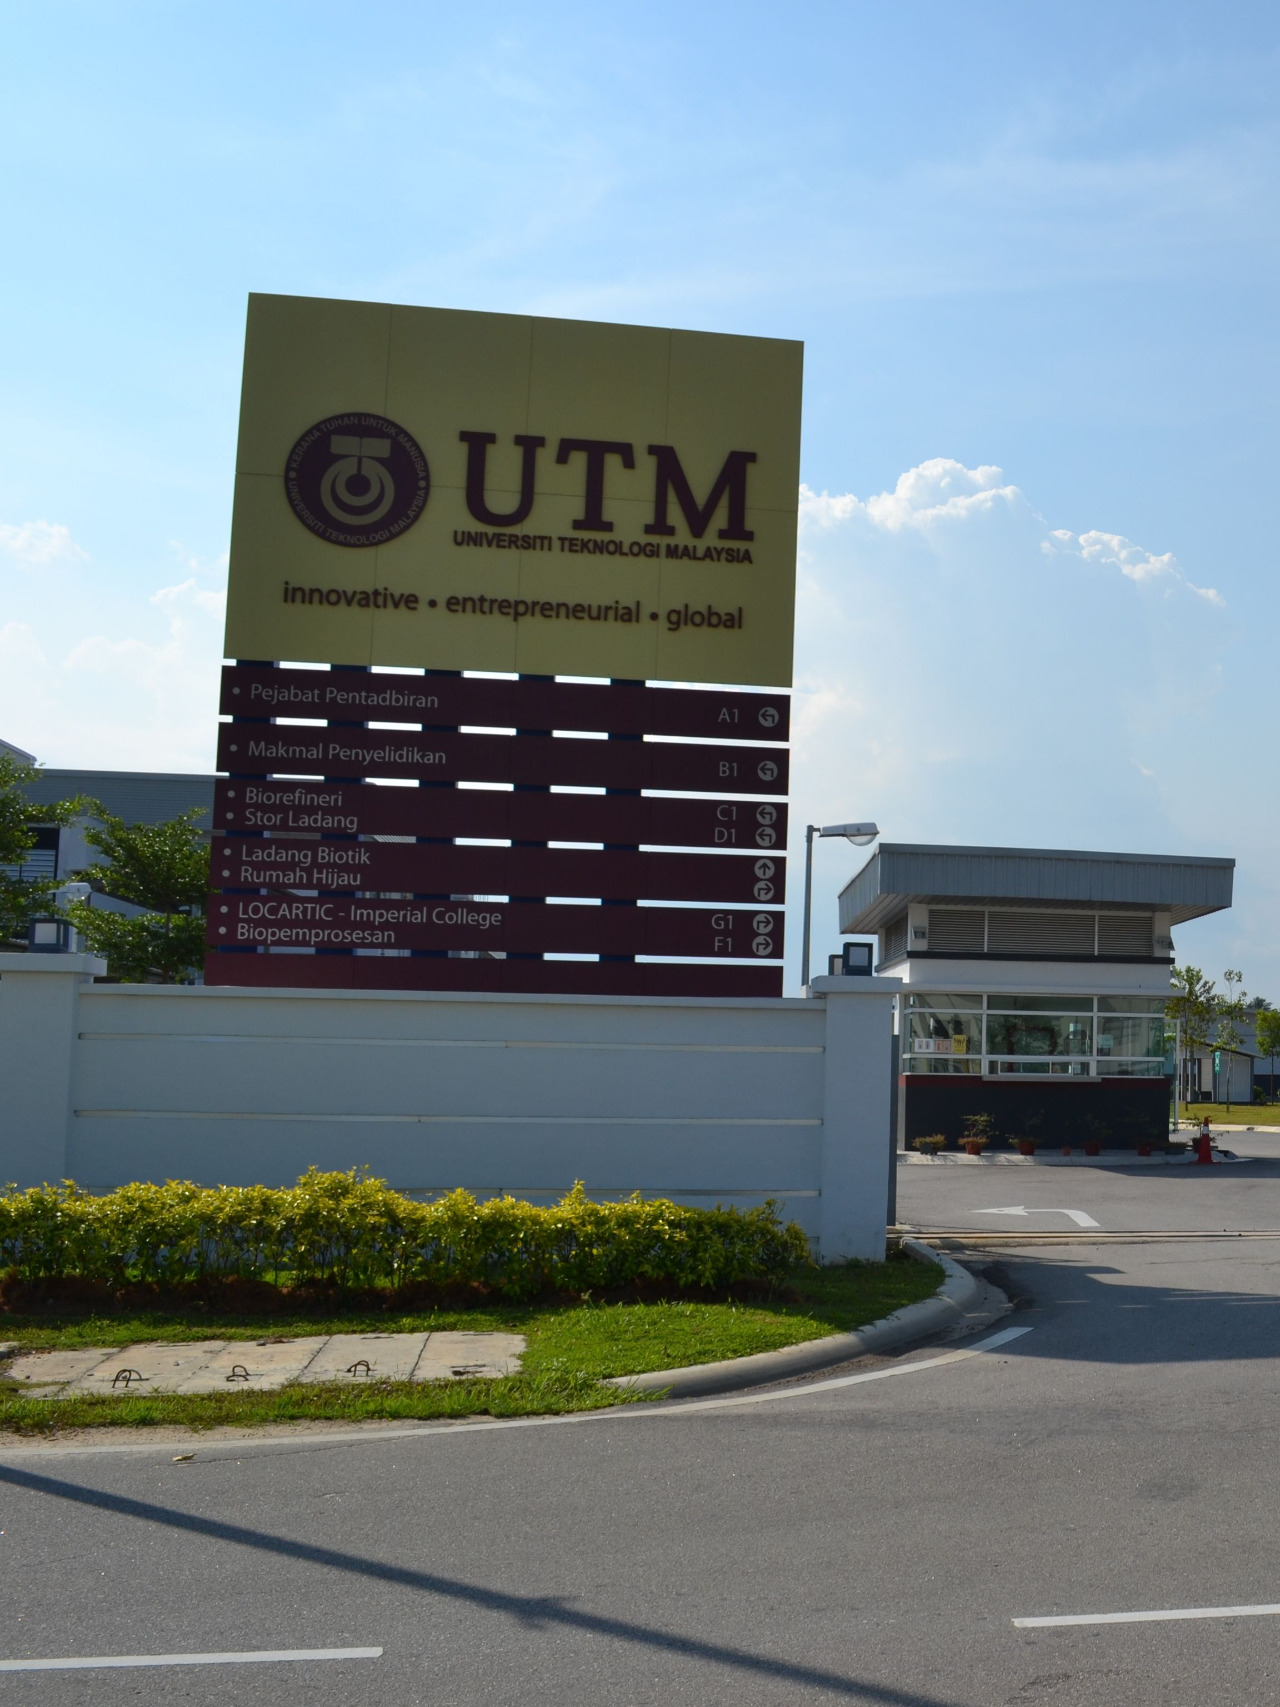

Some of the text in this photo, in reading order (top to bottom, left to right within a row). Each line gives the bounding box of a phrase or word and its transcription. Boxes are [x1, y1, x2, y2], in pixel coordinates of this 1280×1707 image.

[321, 416, 358, 432] TUHAN
[361, 416, 399, 436] UNTUK
[397, 434, 426, 478] MANUSIA
[459, 431, 757, 541] UTM
[288, 481, 427, 545] UNIVERSITI TEKNOLOGI MALAYSIA
[453, 530, 753, 564] UNIVERSITI TEKNOLOGI MALAYSIA
[283, 581, 742, 630] innovative entrepreneurial global
[250, 684, 438, 708] Pejabat Pentadbiran
[718, 708, 739, 723] A1
[248, 740, 446, 765] Makmal Penyelidikan
[719, 762, 738, 777] B1
[245, 788, 342, 807] Biorefineri
[245, 808, 358, 832] Stor Ladang
[716, 805, 737, 821] C1
[714, 828, 736, 843] D1
[242, 845, 370, 866] Ladang Biotik
[240, 866, 361, 889] Rumah Hijau
[238, 901, 334, 920] LOCARTIC
[351, 905, 427, 925] Imperial
[432, 907, 502, 929] College
[711, 914, 734, 930] G1
[237, 923, 395, 945] Biopemprosesan
[714, 937, 733, 952] F1
